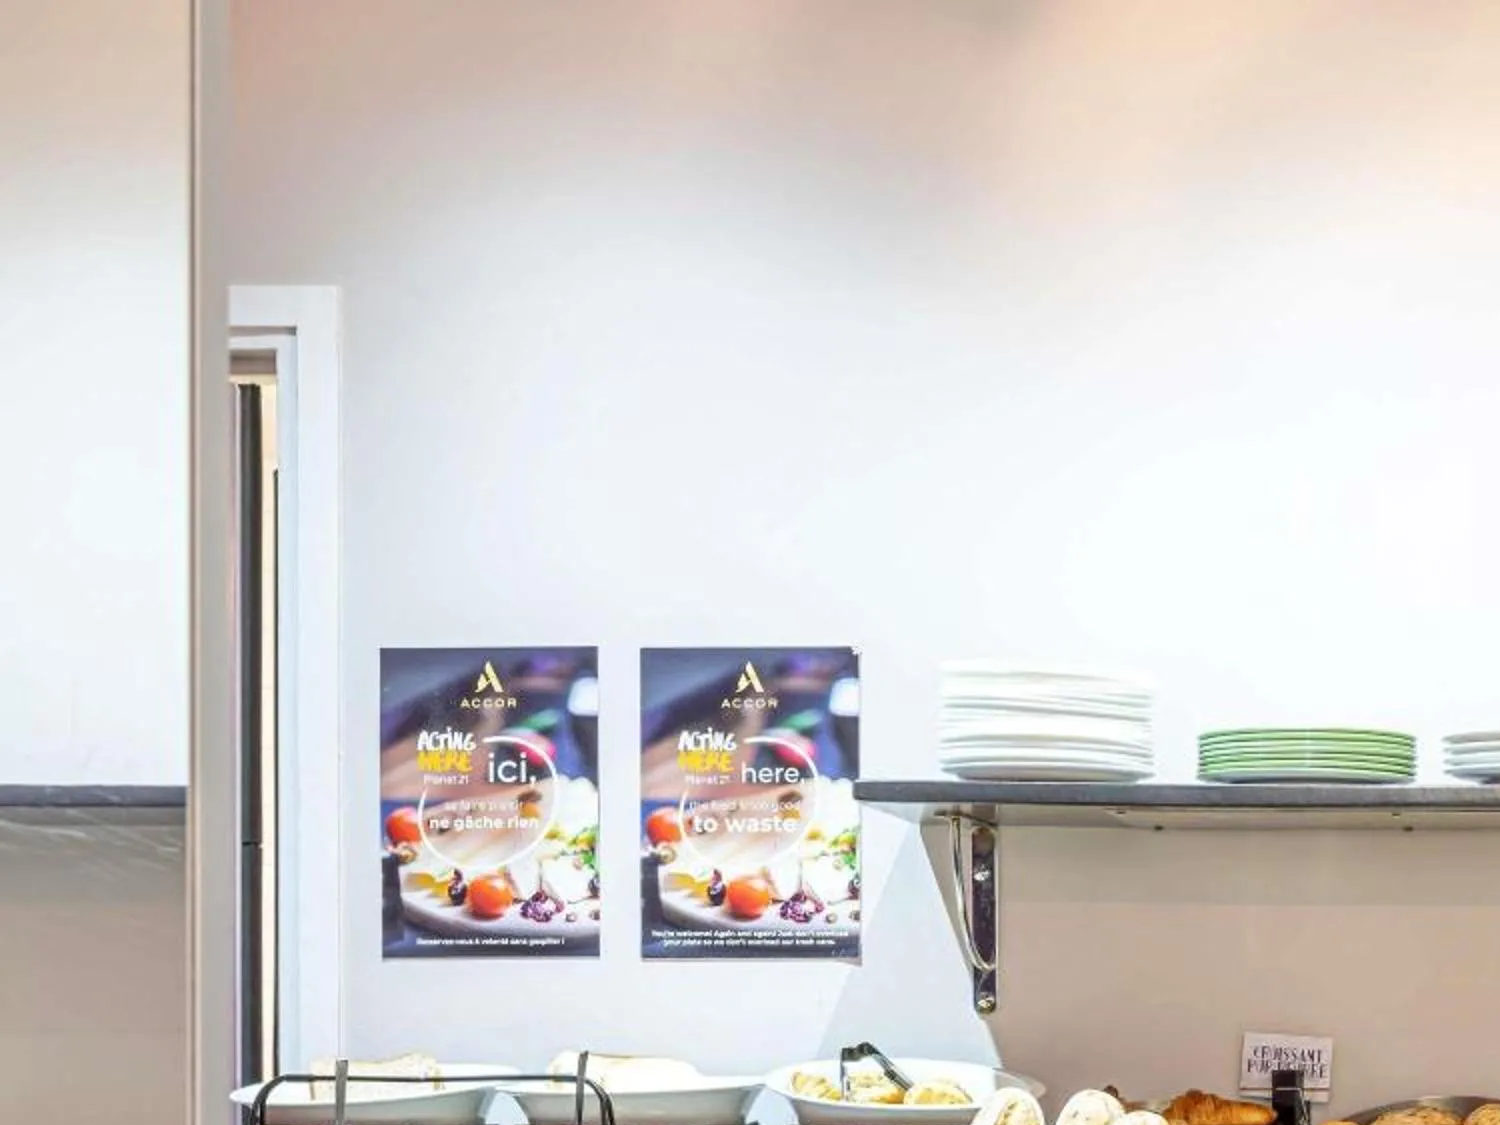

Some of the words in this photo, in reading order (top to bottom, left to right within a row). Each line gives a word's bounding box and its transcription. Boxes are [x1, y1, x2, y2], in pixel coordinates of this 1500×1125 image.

[460, 697, 517, 709] ACCOR
[721, 697, 778, 709] ACCOR
[487, 752, 537, 788] ici,
[428, 820, 451, 829] ne
[506, 816, 539, 830] rien
[694, 816, 719, 832] to
[725, 815, 798, 833] waste
